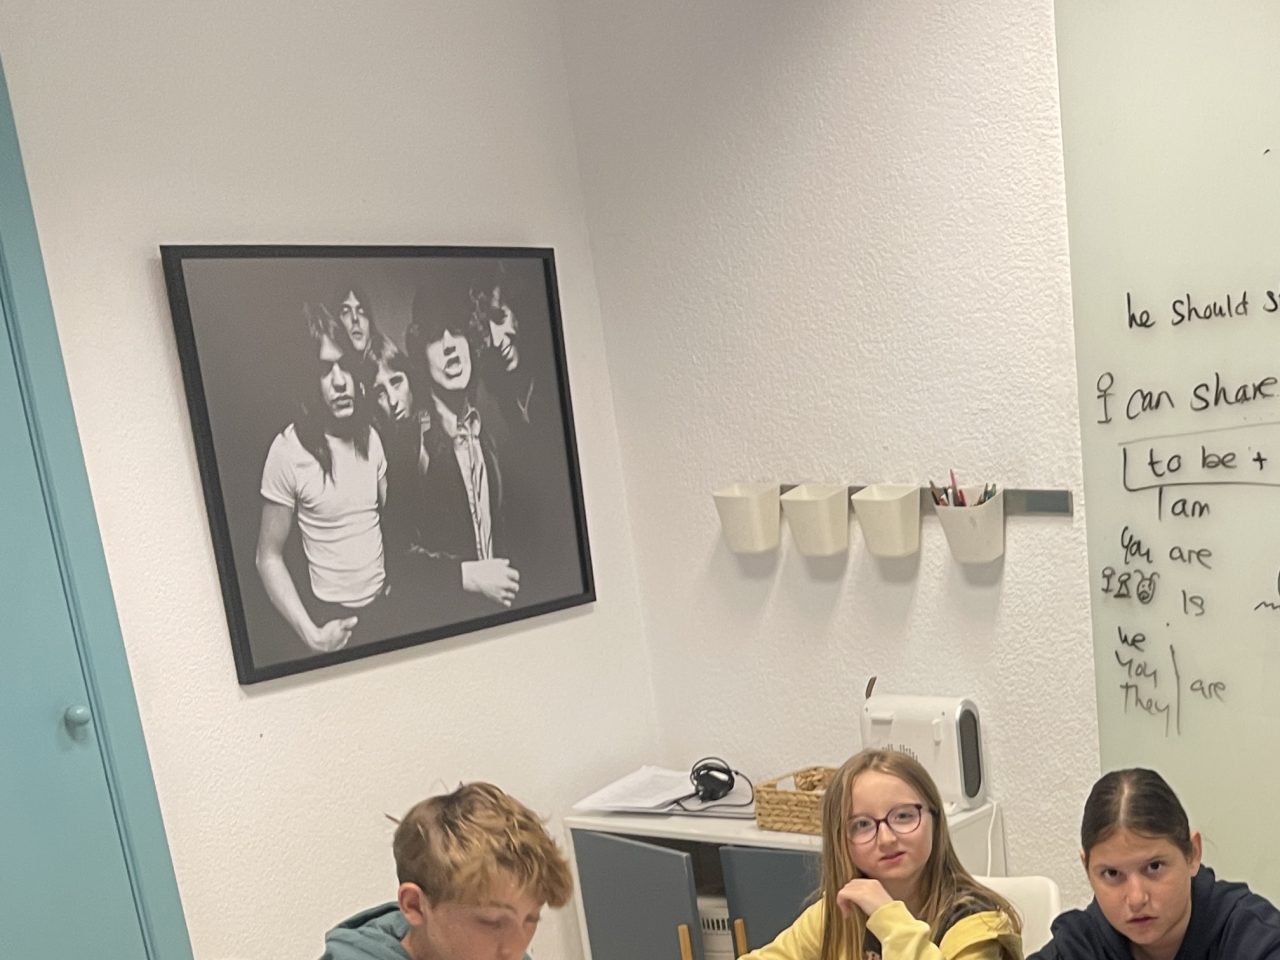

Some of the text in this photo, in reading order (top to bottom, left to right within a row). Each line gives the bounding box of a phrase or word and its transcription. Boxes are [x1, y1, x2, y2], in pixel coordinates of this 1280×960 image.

[1171, 291, 1249, 326] should
[1126, 389, 1174, 420] can
[1190, 372, 1278, 411] share
[1148, 448, 1181, 477] to
[1202, 446, 1238, 469] be
[1171, 498, 1210, 518] am
[1169, 546, 1212, 570] are
[1190, 679, 1226, 702] are
